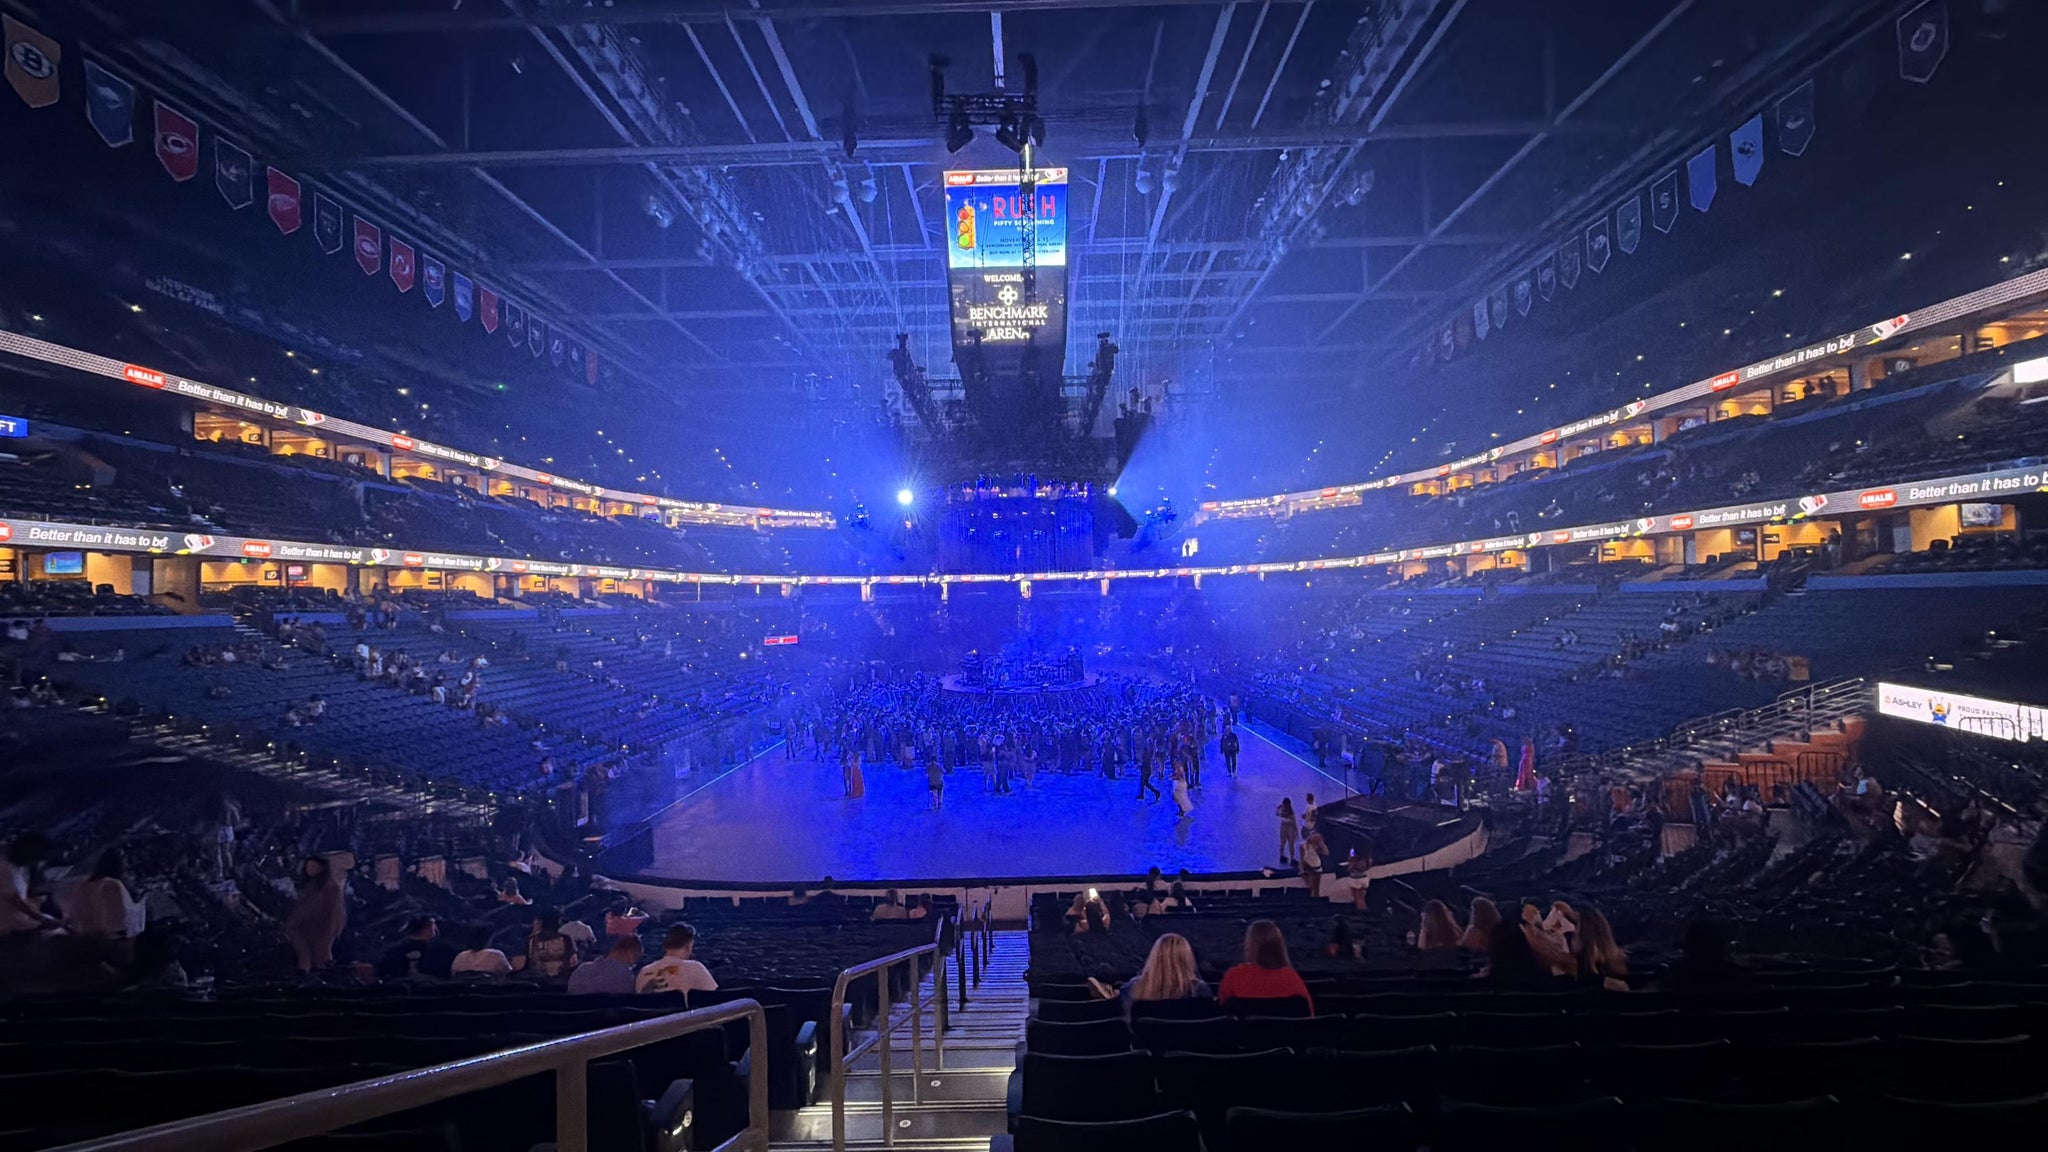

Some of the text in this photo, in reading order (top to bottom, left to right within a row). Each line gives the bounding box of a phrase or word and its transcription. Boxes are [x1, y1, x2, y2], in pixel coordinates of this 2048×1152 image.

[1014, 219, 1055, 227] SOHING
[984, 274, 1022, 282] WELCOME
[969, 306, 1048, 320] BENCHMARK
[972, 319, 1046, 327] INTERNATIONAL
[1747, 363, 1775, 378] Better
[1775, 355, 1796, 370] than
[1798, 351, 1805, 362] it
[1805, 346, 1825, 360] has
[1827, 342, 1838, 354] to
[127, 369, 163, 385] AMALIE
[1713, 374, 1736, 386] AMALIE
[178, 380, 212, 398] Better
[212, 390, 236, 404] than
[237, 395, 244, 406] it
[245, 398, 263, 411] has
[264, 402, 274, 413] to
[1909, 485, 1949, 500] Better
[1949, 481, 1978, 495] than
[1981, 479, 1990, 491] it
[1993, 476, 2020, 490] has
[2023, 474, 2039, 486] to
[1861, 492, 1894, 505] AMALIE
[29, 527, 74, 542] Better
[73, 531, 102, 544] than
[104, 533, 112, 544] it
[113, 534, 137, 546] has
[138, 535, 150, 547] to
[1892, 697, 1923, 710] ASHLEY
[1958, 705, 1981, 714] PROUD
